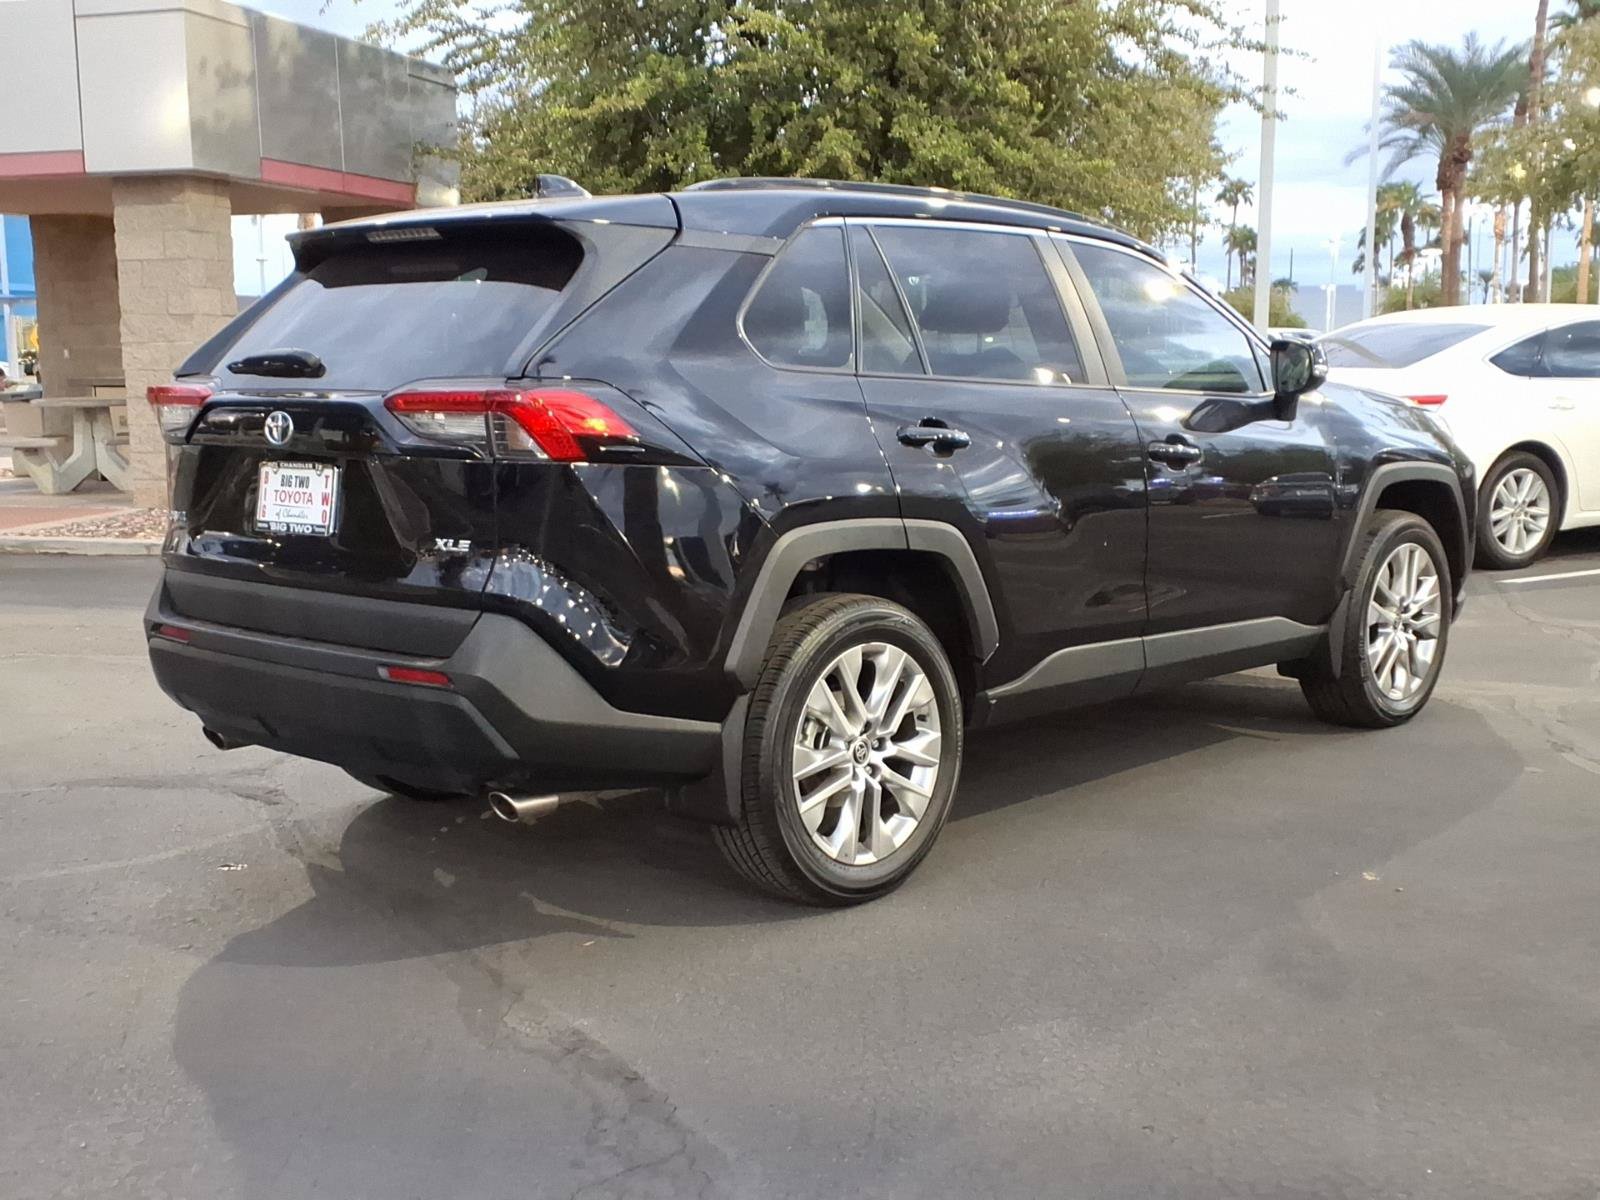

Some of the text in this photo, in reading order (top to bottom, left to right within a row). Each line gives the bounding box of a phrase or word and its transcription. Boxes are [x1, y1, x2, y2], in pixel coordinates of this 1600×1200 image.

[280, 474, 310, 489] BIG TWO
[274, 490, 313, 505] TOYOTA
[269, 522, 288, 531] BIG
[289, 523, 312, 533] TWO
[434, 537, 472, 552] XLE
